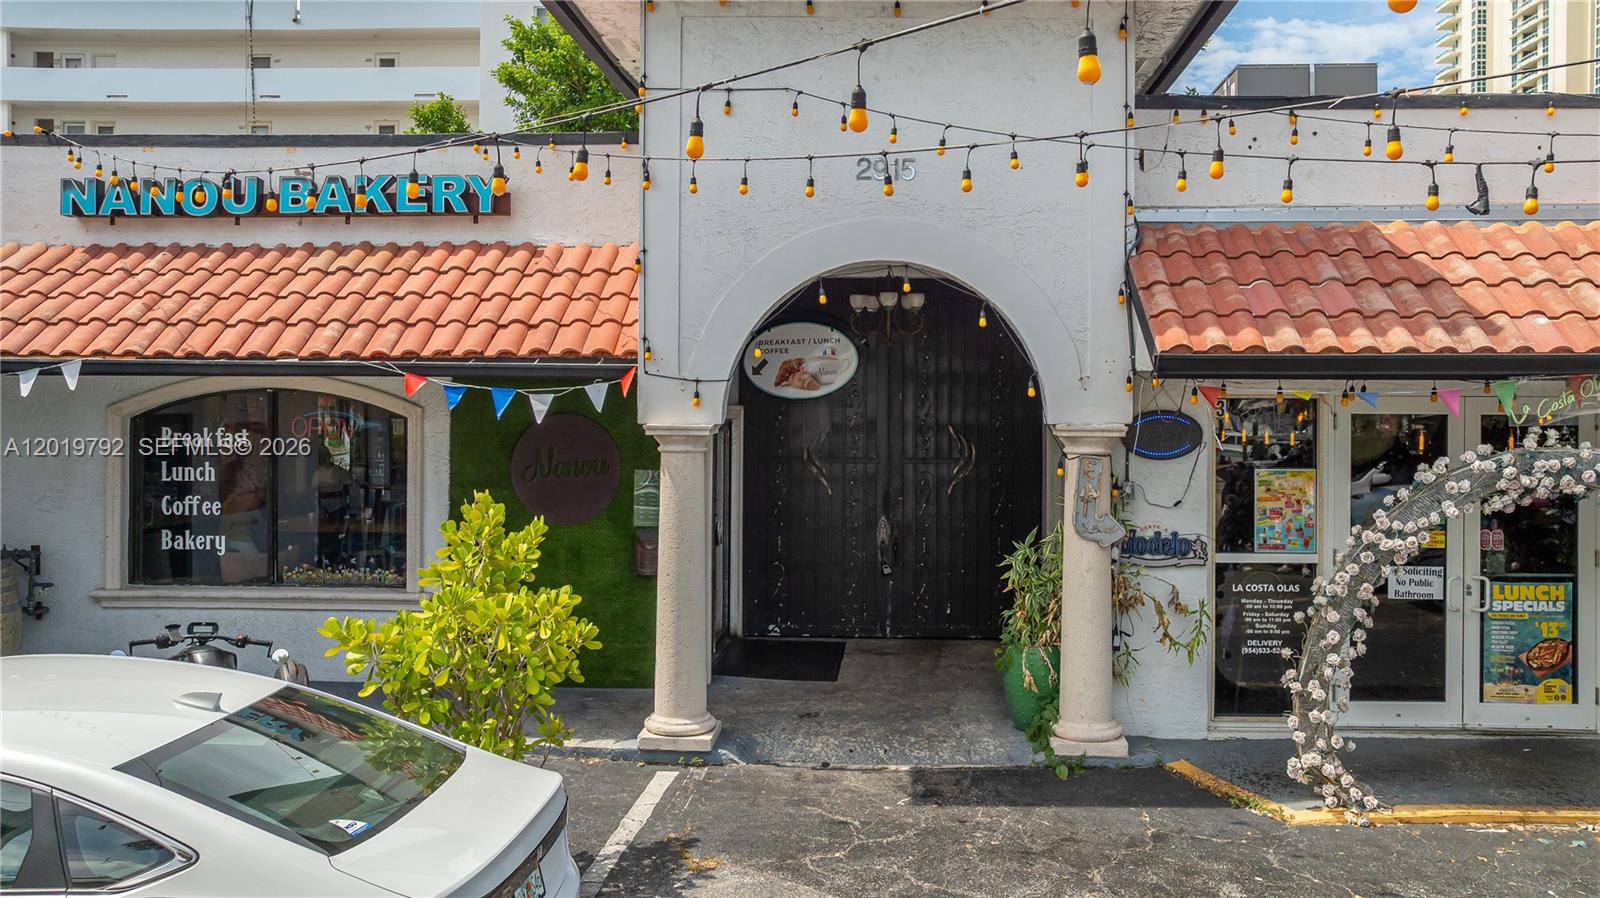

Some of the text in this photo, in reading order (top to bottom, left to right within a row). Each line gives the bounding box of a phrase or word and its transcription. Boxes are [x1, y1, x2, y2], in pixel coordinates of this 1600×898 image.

[856, 157, 917, 181] 2915
[60, 174, 506, 217] NANOU BAKERY
[813, 337, 841, 345] LUNCH
[1537, 390, 1575, 418] Costa
[1580, 374, 1600, 397] Ol
[161, 426, 250, 447] Breakfast
[160, 460, 216, 482] Lunch
[160, 495, 222, 516] Coffee
[160, 528, 227, 556] Bakery
[1402, 567, 1443, 578] Soliciting
[1232, 583, 1300, 592] LA COSTA OLAS
[1395, 578, 1435, 588] No Public
[1492, 584, 1566, 600] LUNCH
[1394, 590, 1435, 599] Bathroom
[1491, 600, 1566, 612] SPECIALS
